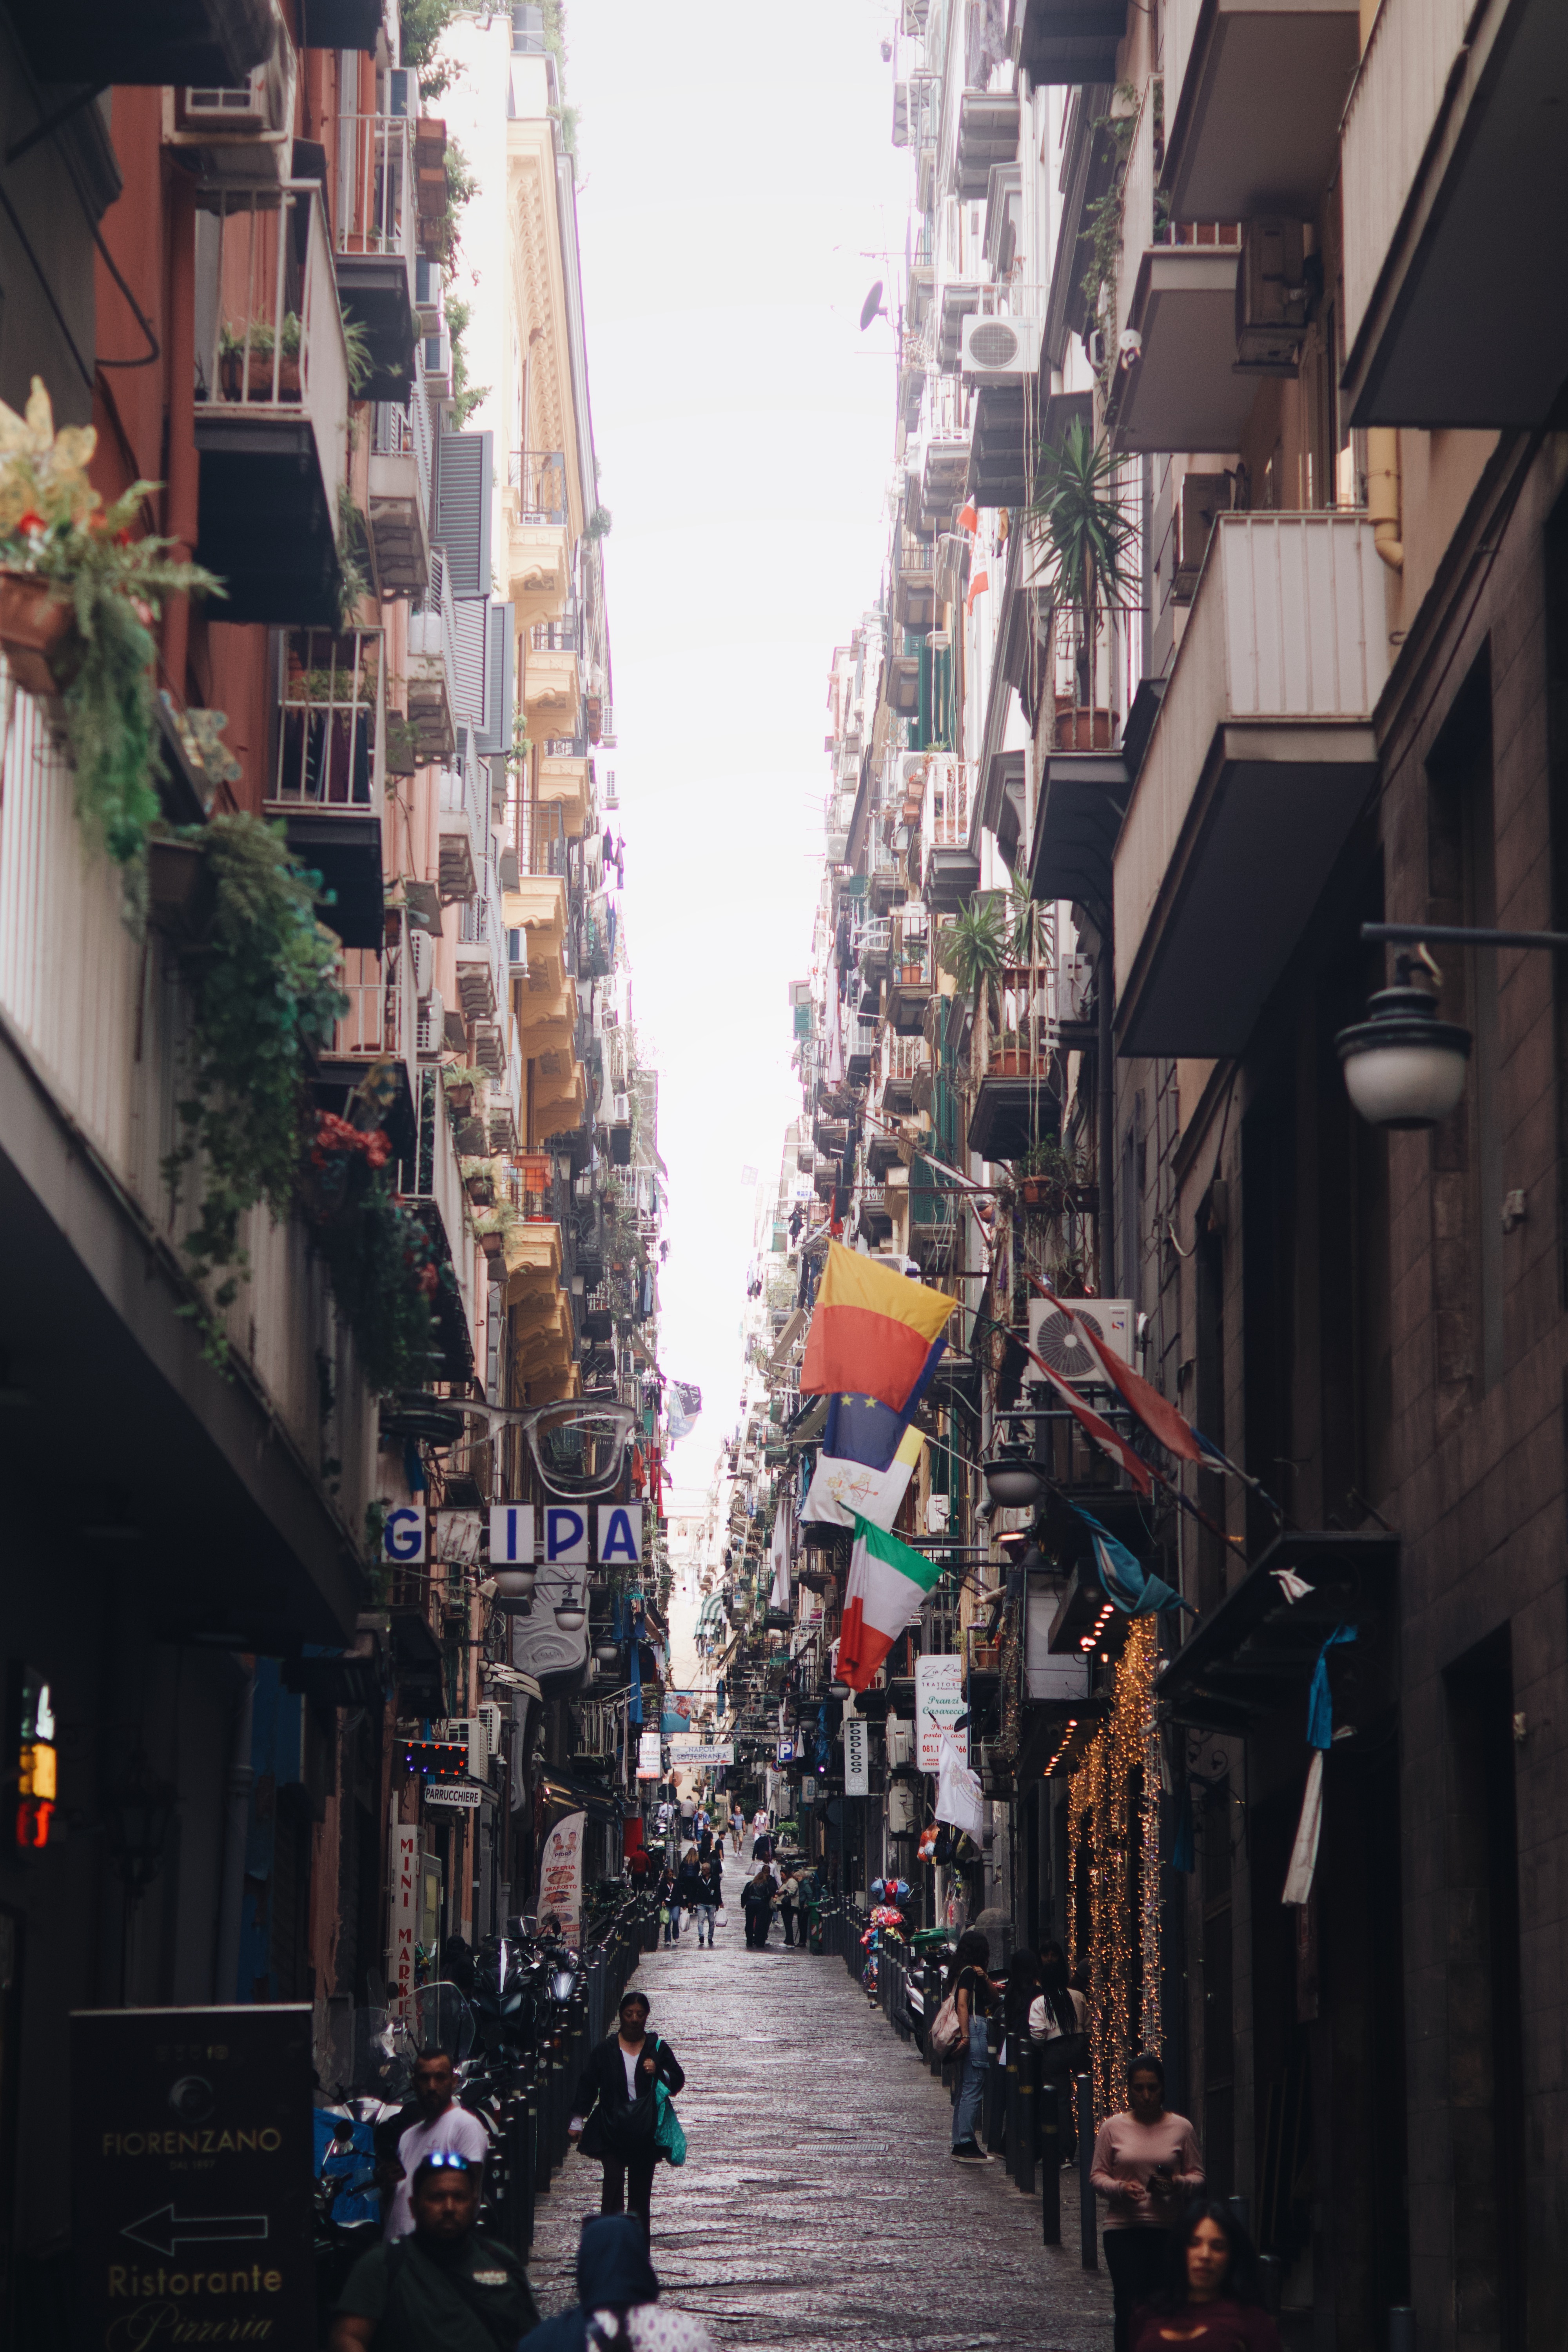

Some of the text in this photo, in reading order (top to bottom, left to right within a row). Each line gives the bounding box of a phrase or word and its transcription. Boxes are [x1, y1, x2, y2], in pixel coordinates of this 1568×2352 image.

[922, 1665, 938, 1677] Zia
[922, 1706, 965, 1715] Casarecci
[927, 1696, 959, 1704] Pranzi
[780, 1744, 791, 1759] P
[850, 1722, 862, 1773] PODOLOGO
[425, 1788, 479, 1803] PARRUCCHIERE
[400, 1838, 413, 1907] MINI
[398, 1928, 413, 2029] MARKE
[102, 2127, 283, 2157] FIORENZANO
[108, 2264, 283, 2298] Ristorante
[105, 2300, 274, 2352] Pizzeria
